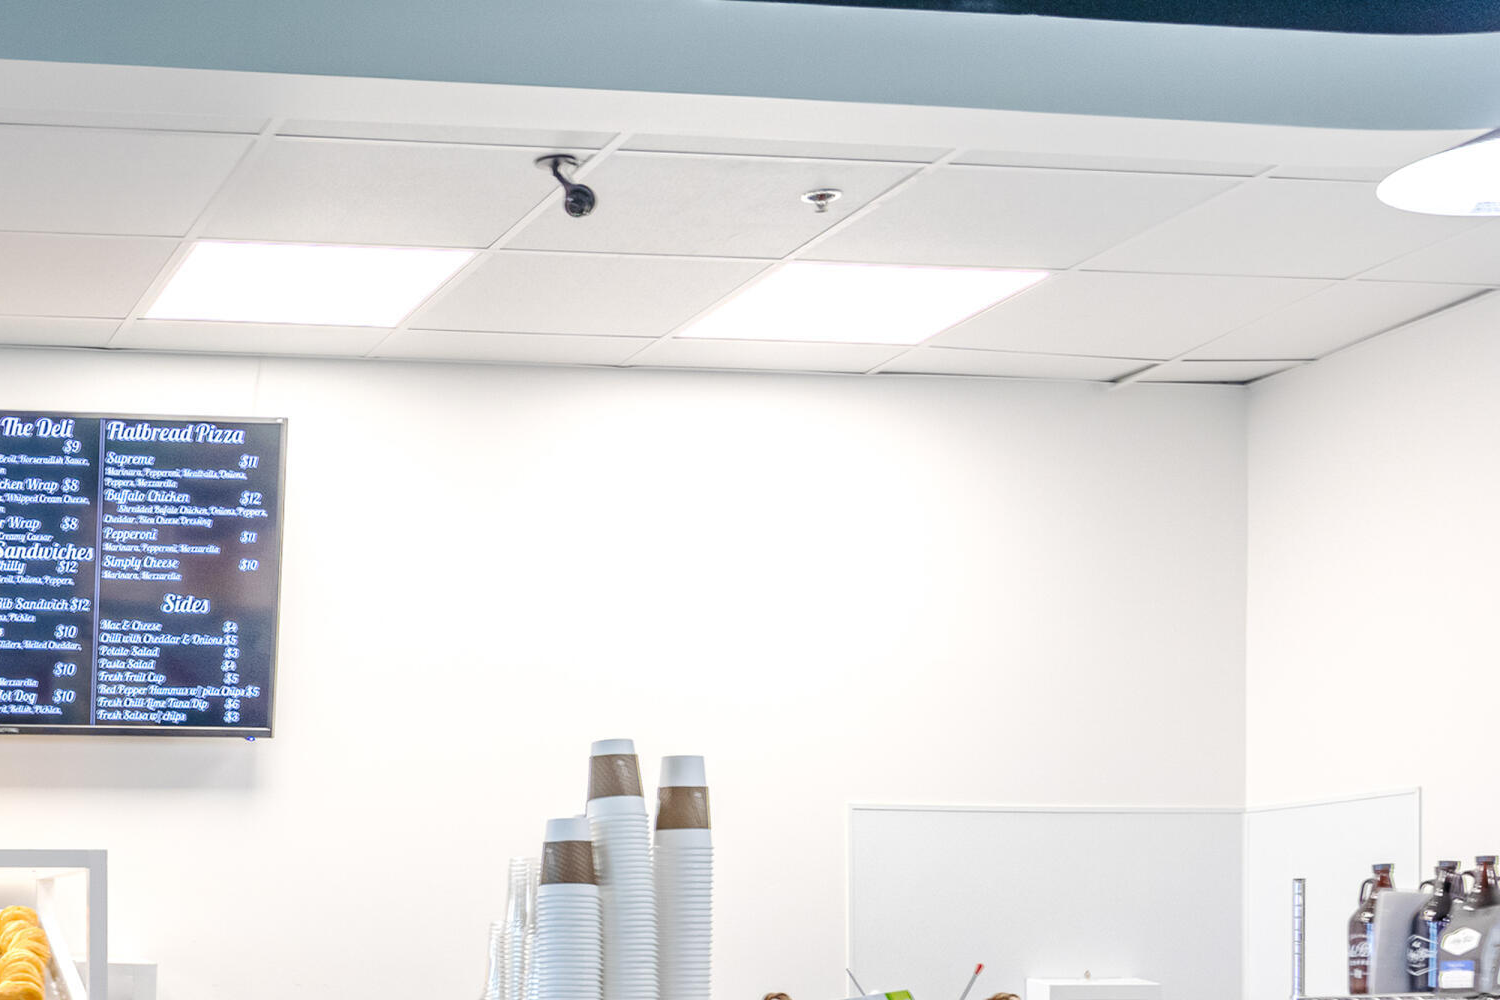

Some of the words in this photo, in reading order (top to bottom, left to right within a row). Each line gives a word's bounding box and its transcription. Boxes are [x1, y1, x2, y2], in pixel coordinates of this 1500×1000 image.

[0, 417, 34, 437] The
[36, 418, 75, 438] Deli
[107, 421, 194, 442] Flatbread
[194, 423, 245, 444] Pizza
[62, 439, 81, 453] $9
[106, 452, 155, 466] Supreme
[239, 454, 259, 469] $11
[104, 489, 145, 504] Buffalo
[147, 490, 190, 504] Chicken
[240, 491, 262, 506] $12
[6, 517, 41, 531] Wrap
[60, 517, 79, 531] $8
[103, 556, 142, 571] Simply
[143, 557, 180, 569] Cheese
[239, 558, 259, 571] $10
[15, 598, 68, 611] Sandwich
[69, 597, 91, 612] $12
[161, 593, 210, 614] Sides
[53, 661, 76, 676] $10
[98, 671, 124, 682] Fresh
[125, 672, 146, 682] Fruit
[147, 672, 166, 684] Cup
[223, 672, 239, 685] $5
